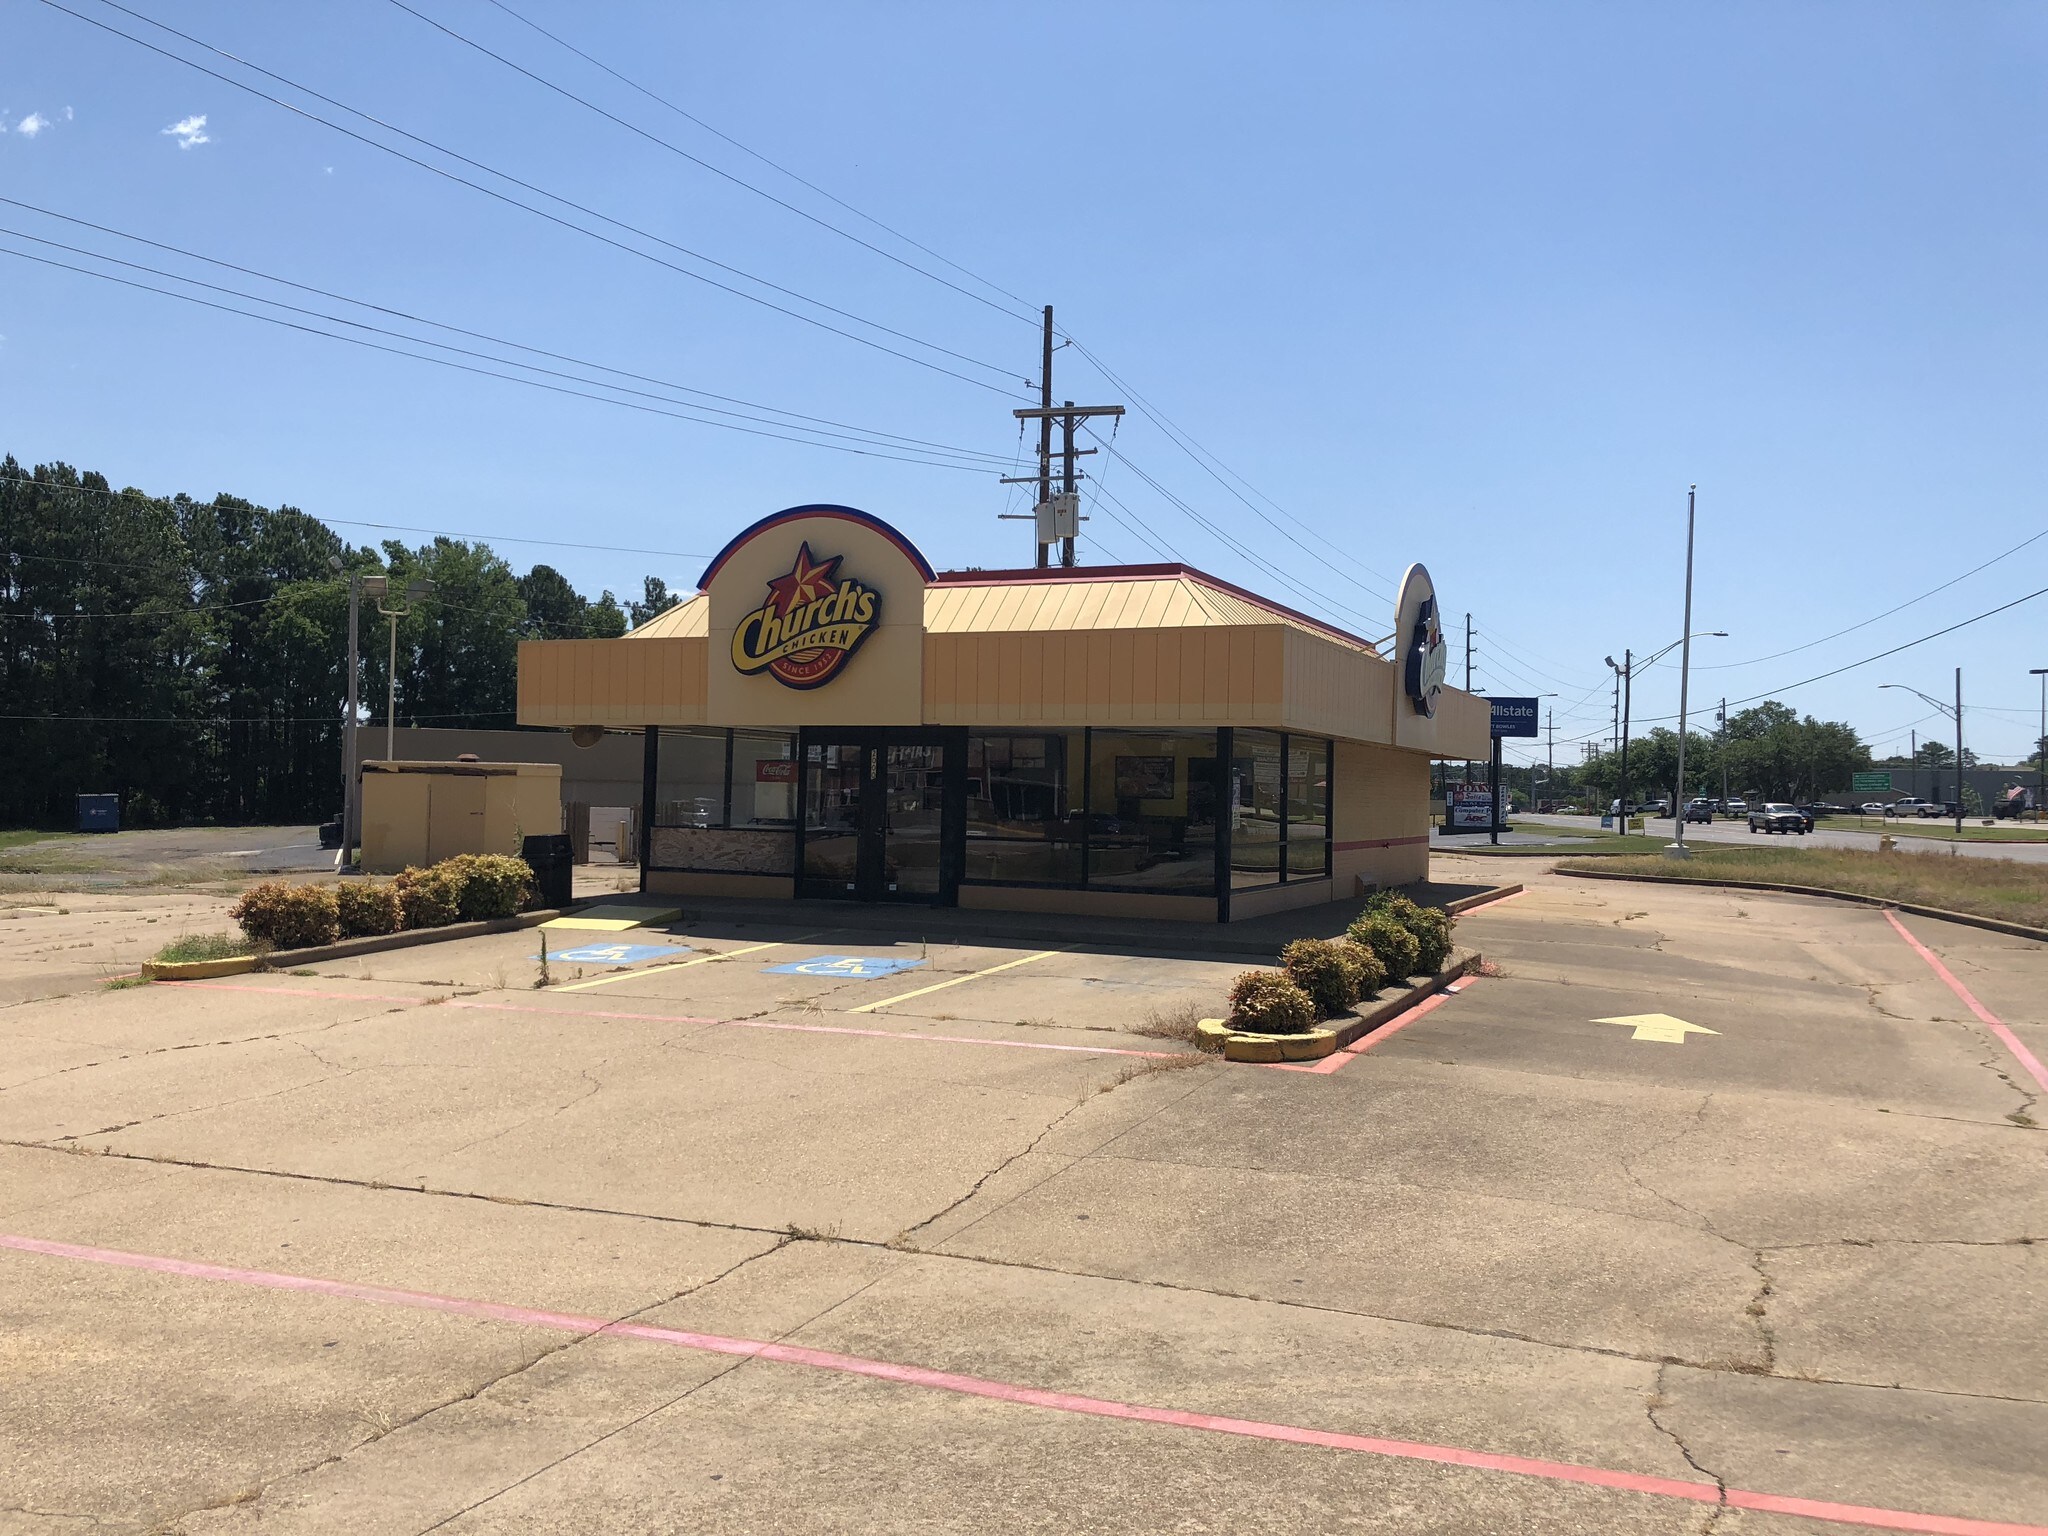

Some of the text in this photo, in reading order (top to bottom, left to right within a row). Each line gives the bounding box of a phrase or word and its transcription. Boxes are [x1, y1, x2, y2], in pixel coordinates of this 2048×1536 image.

[732, 581, 875, 671] Church's
[783, 630, 849, 653] CHICKEN
[783, 653, 832, 675] SINCE 1952
[1491, 705, 1533, 717] Allstate
